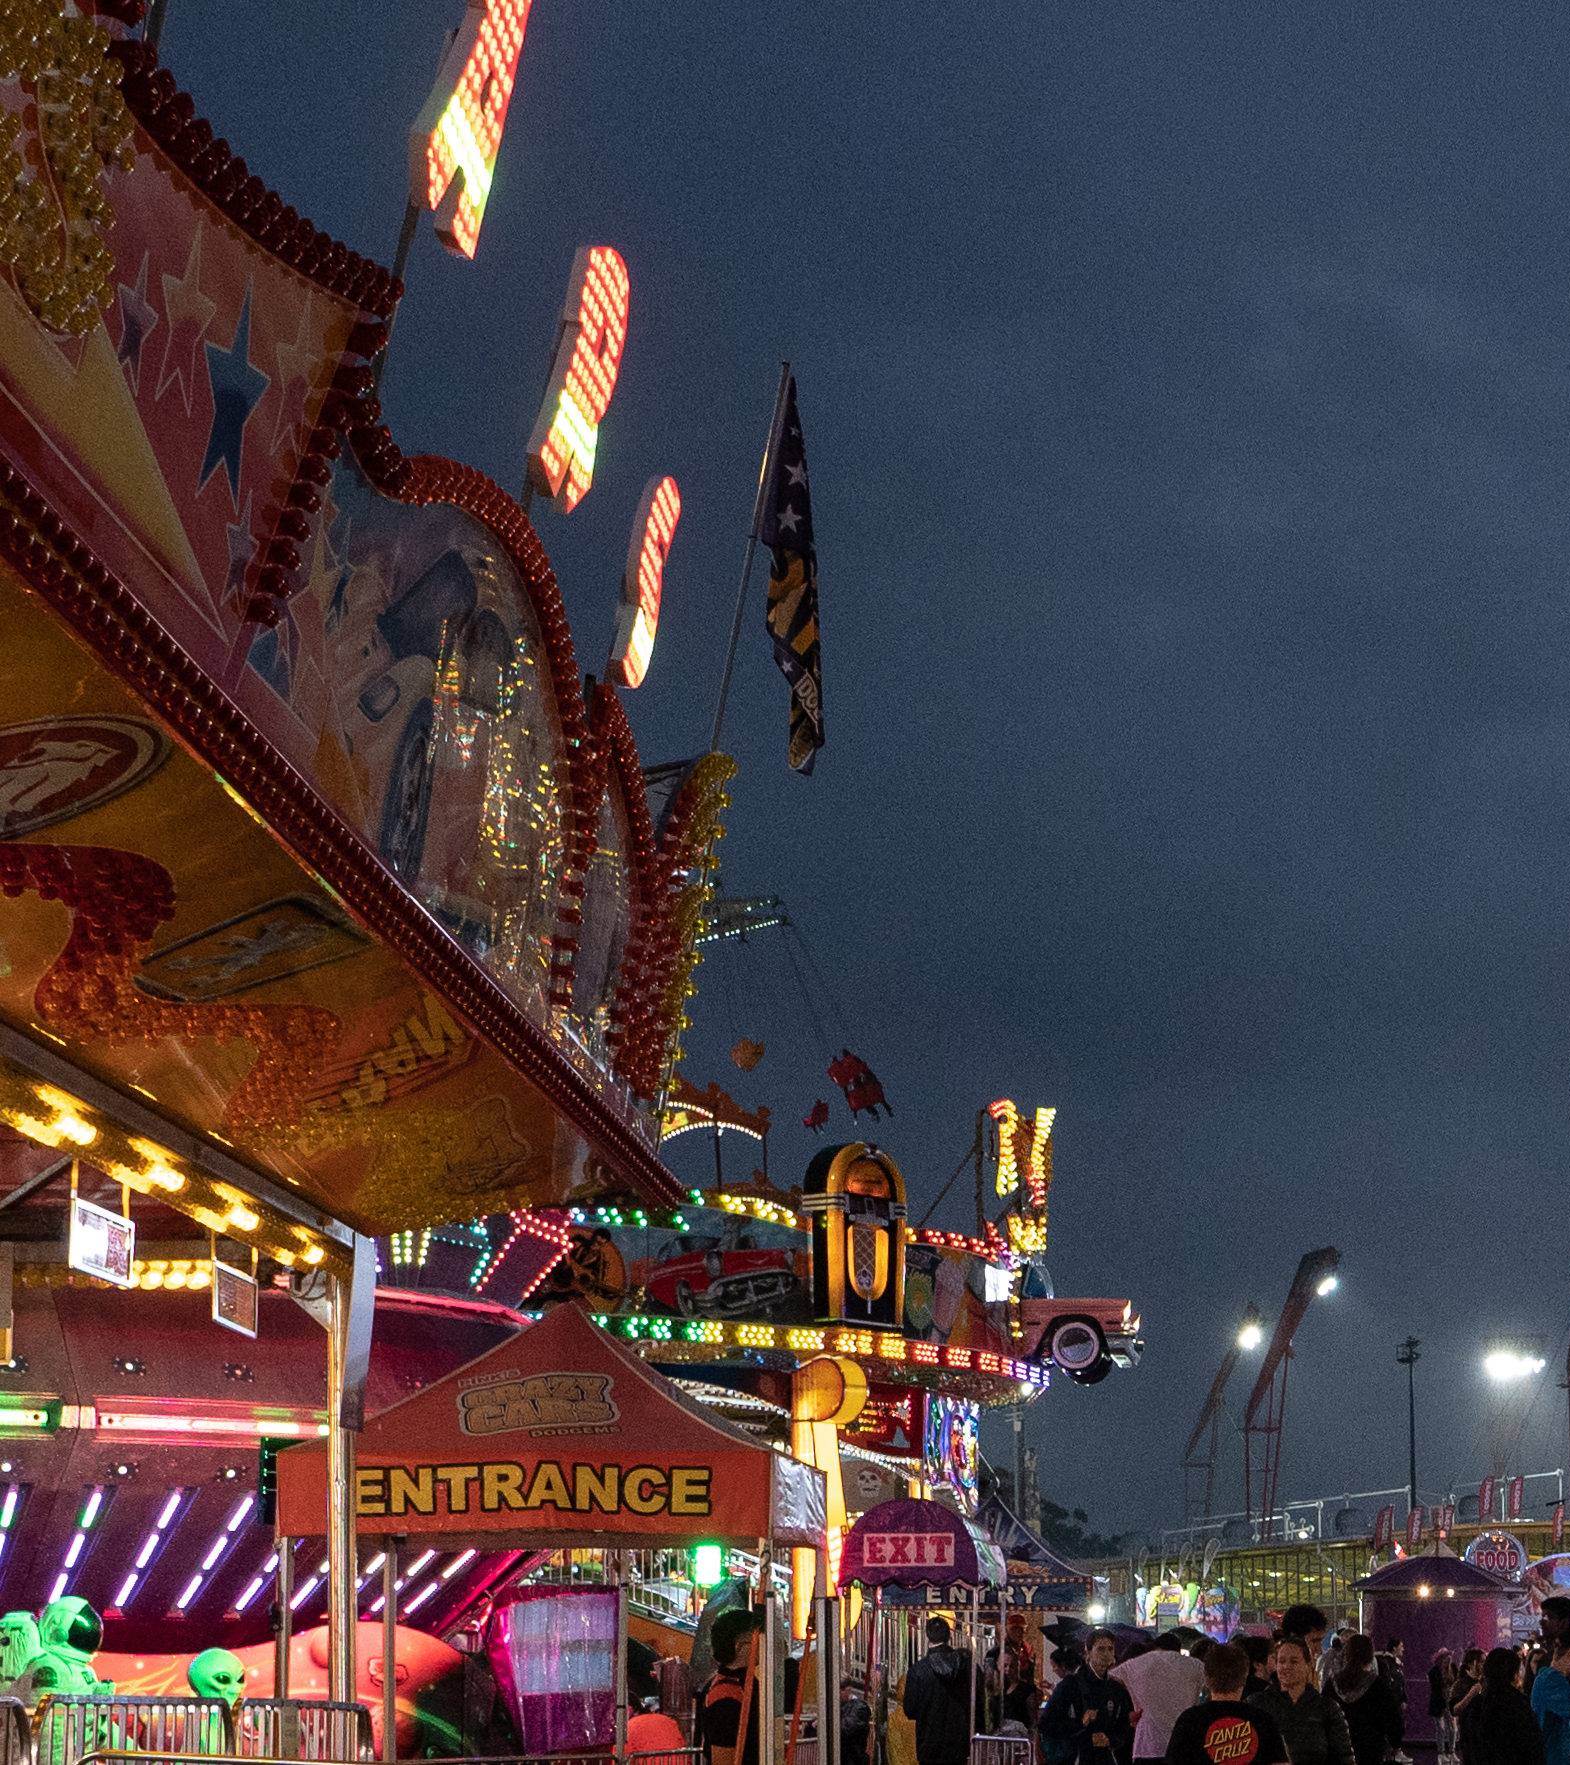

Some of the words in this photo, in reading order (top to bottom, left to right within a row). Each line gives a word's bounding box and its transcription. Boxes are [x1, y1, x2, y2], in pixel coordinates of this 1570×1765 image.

[464, 1374, 608, 1408] CRAZY
[467, 1400, 613, 1434] CARS
[529, 1426, 622, 1438] DODGEMS
[355, 1460, 712, 1516] ENTRANCE
[866, 1535, 952, 1565] EXIT
[1476, 1550, 1519, 1572] FOOD
[926, 1585, 1039, 1604] ENTRY
[1203, 1720, 1252, 1749] SANTA
[1213, 1737, 1252, 1764] CRUZ
